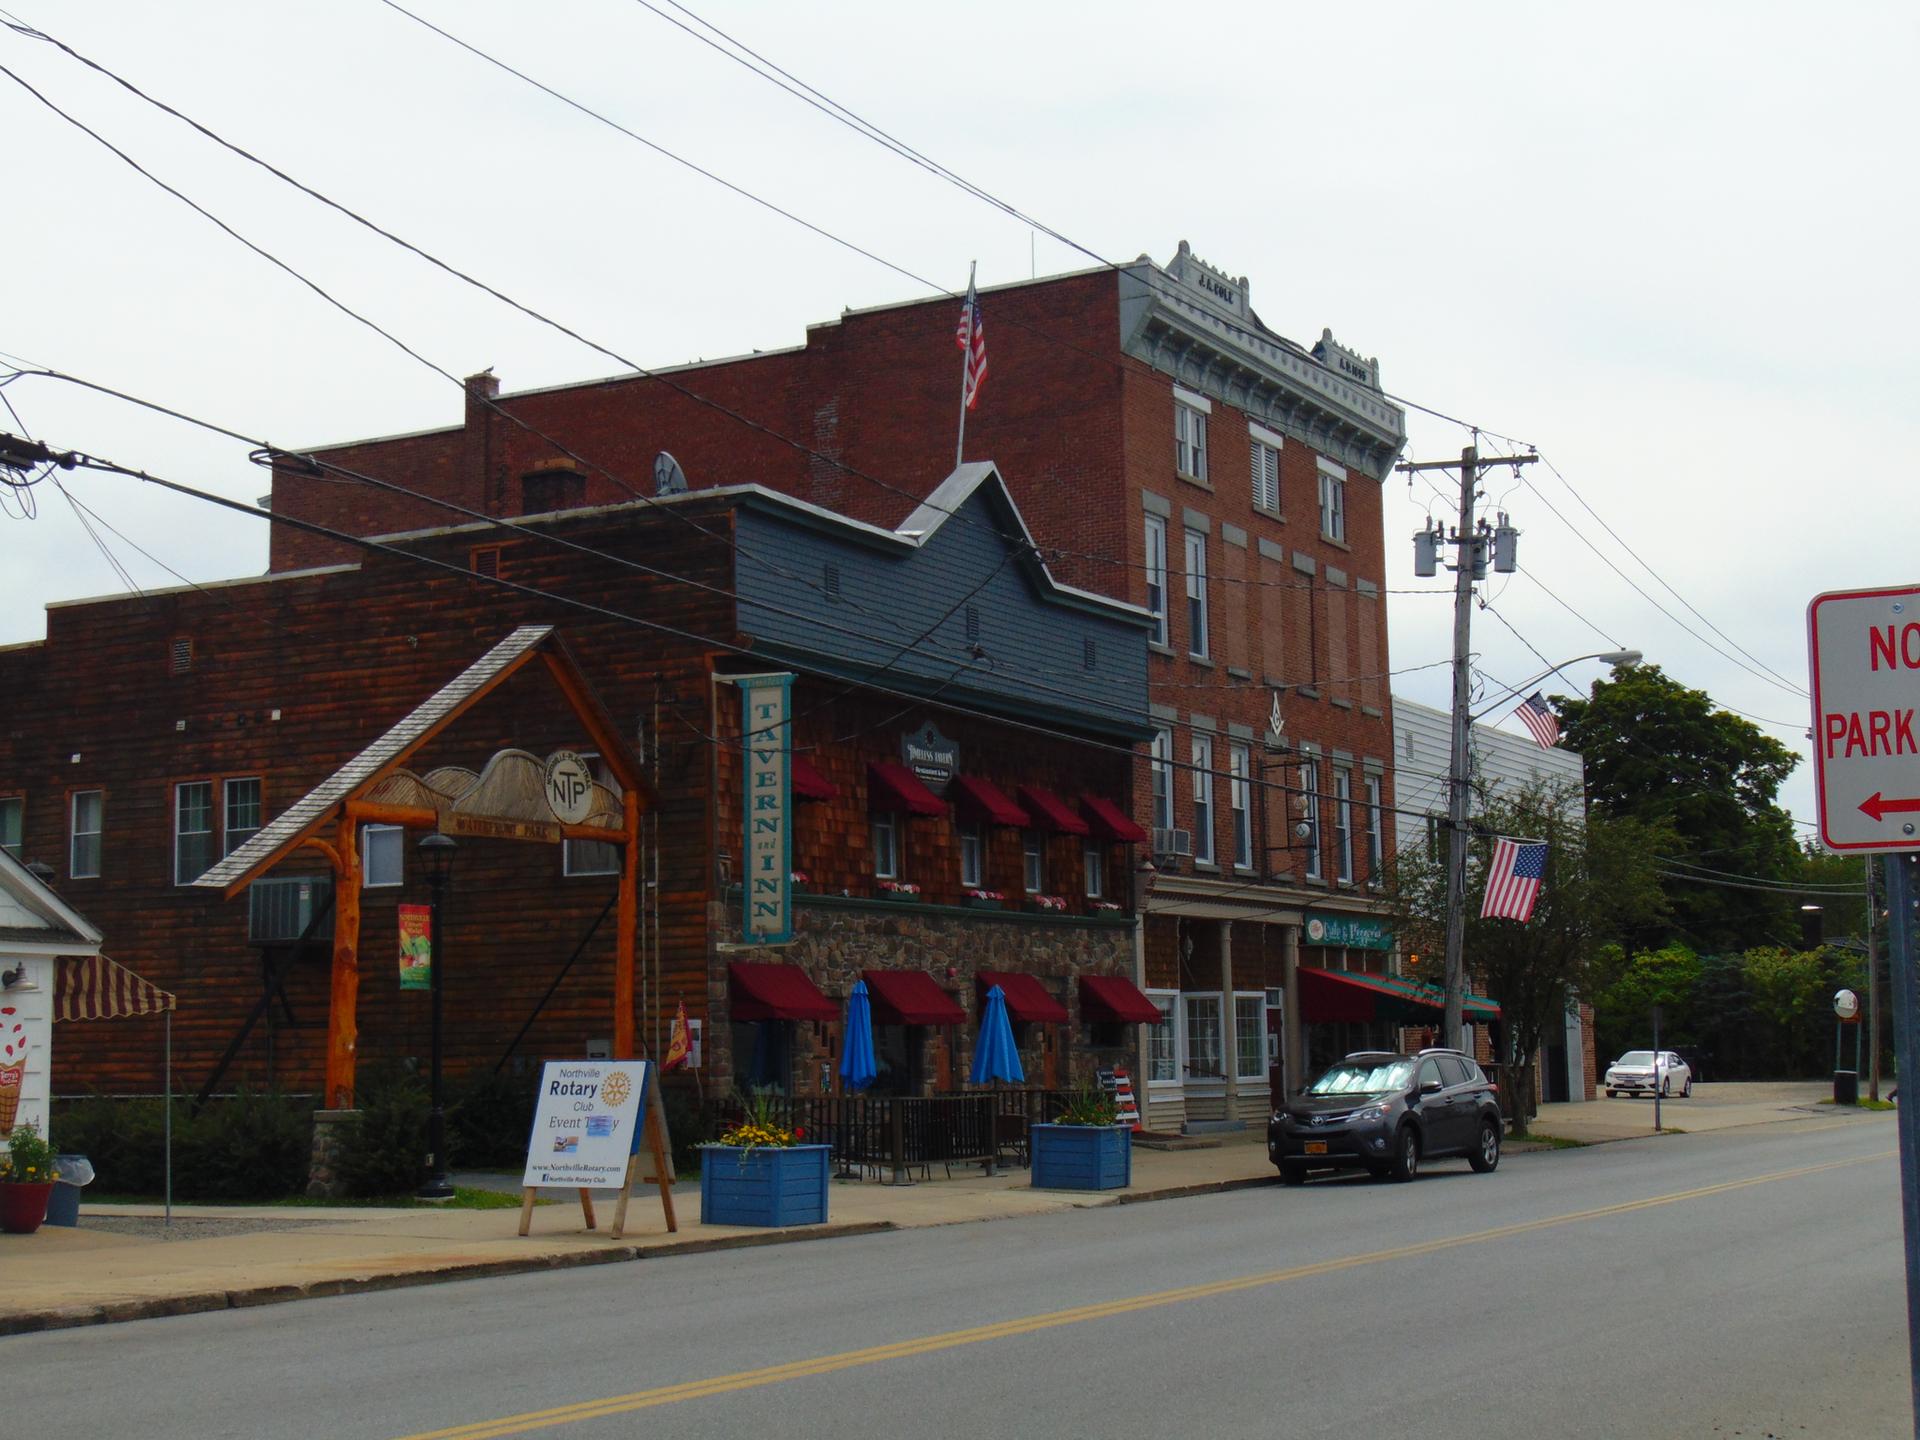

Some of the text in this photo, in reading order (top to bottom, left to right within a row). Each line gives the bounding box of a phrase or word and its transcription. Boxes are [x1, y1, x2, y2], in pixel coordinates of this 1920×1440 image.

[1869, 622, 1920, 671] NO
[754, 703, 780, 834] TAVERN
[758, 838, 776, 849] and
[753, 854, 780, 917] INN
[560, 1069, 600, 1078] Northville
[549, 1081, 598, 1098] Rotary
[573, 1101, 594, 1112] Club
[549, 1115, 581, 1129] Event
[532, 1163, 621, 1173] www.NorthvilleRotary.com
[575, 1176, 592, 1184] Rotary
